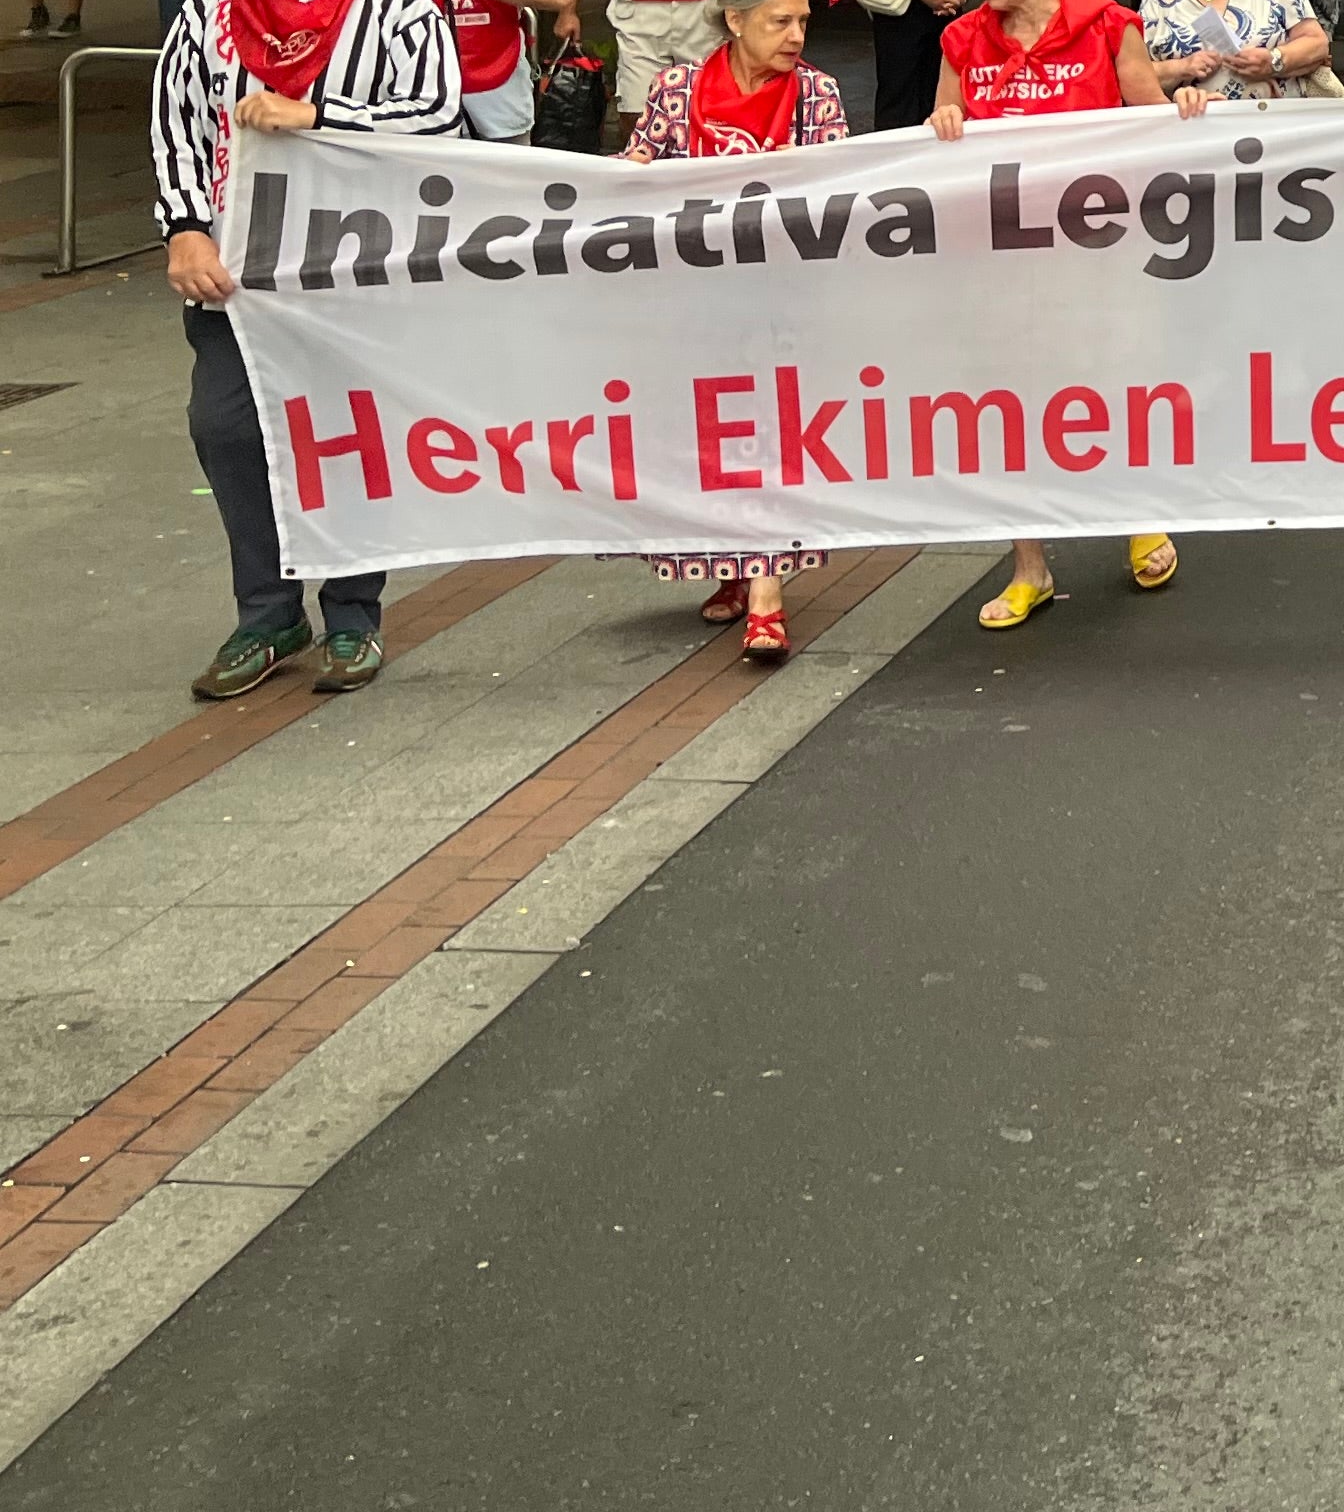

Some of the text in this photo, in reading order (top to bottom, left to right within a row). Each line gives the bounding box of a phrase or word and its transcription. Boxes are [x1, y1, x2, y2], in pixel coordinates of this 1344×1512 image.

[240, 171, 937, 292] Iniciativa
[283, 378, 638, 512] Herri
[693, 365, 1195, 493] Ekimen
